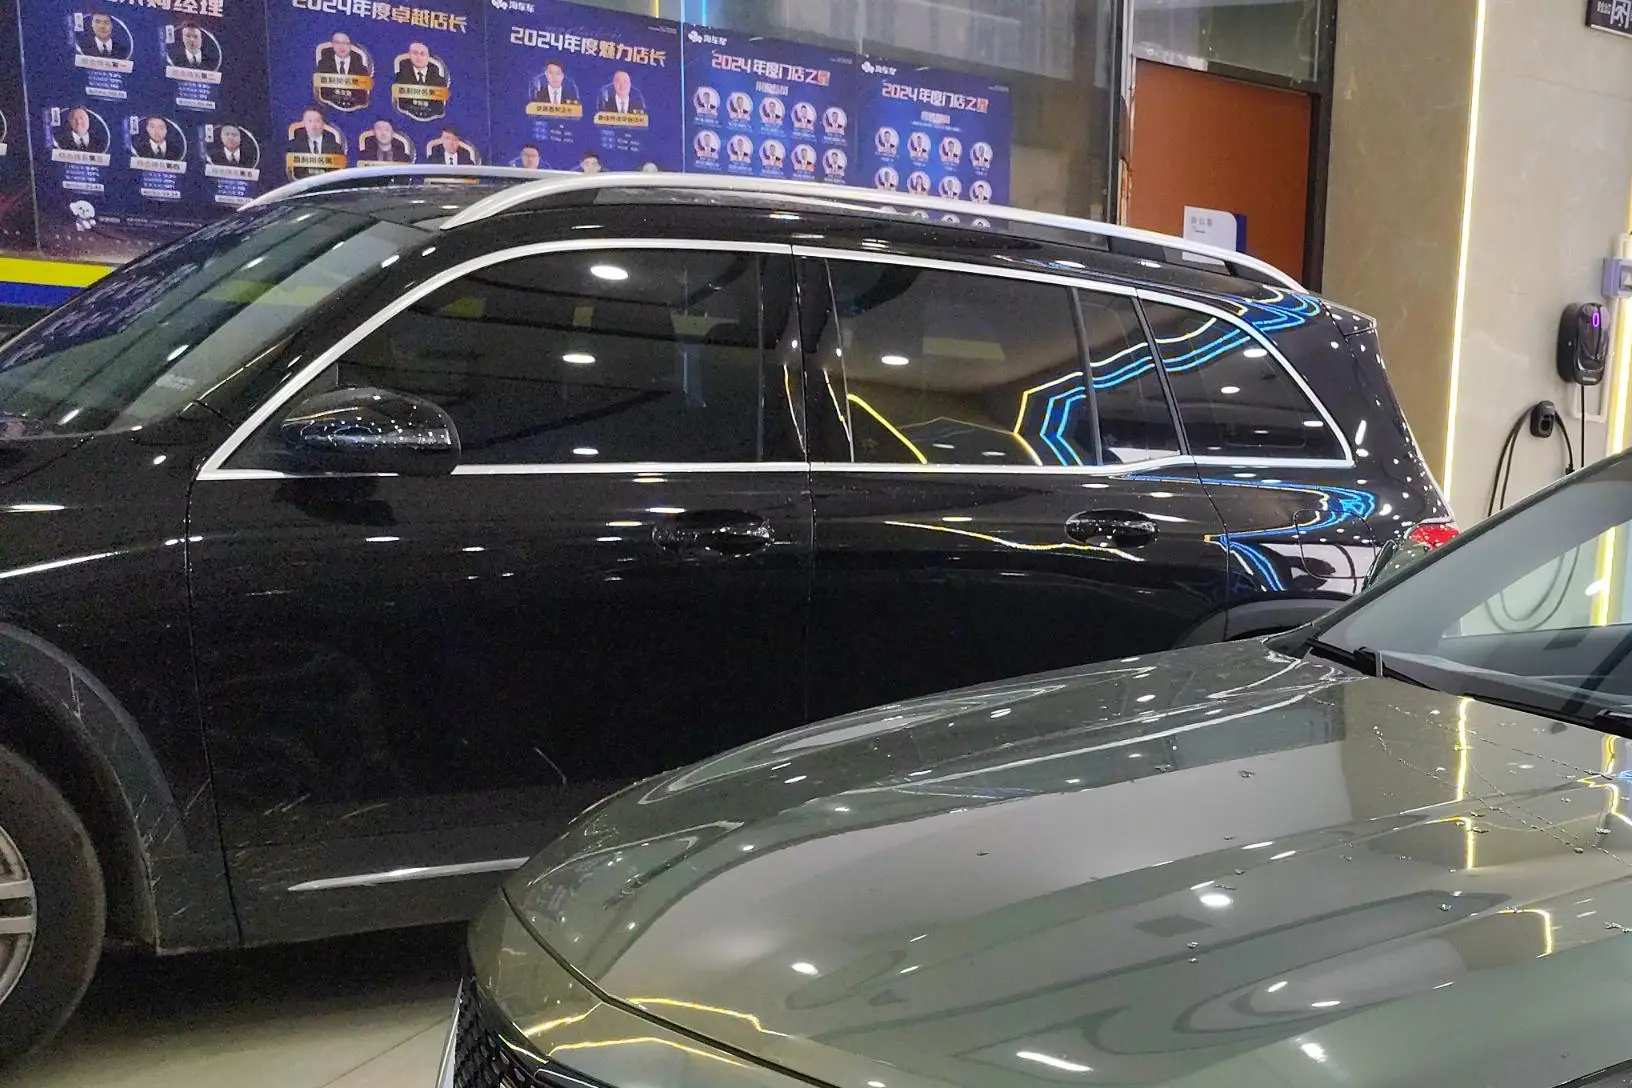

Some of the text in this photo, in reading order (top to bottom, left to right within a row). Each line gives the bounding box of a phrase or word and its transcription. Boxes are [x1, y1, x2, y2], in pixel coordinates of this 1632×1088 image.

[510, 27, 667, 67] 2024年度魅力店长
